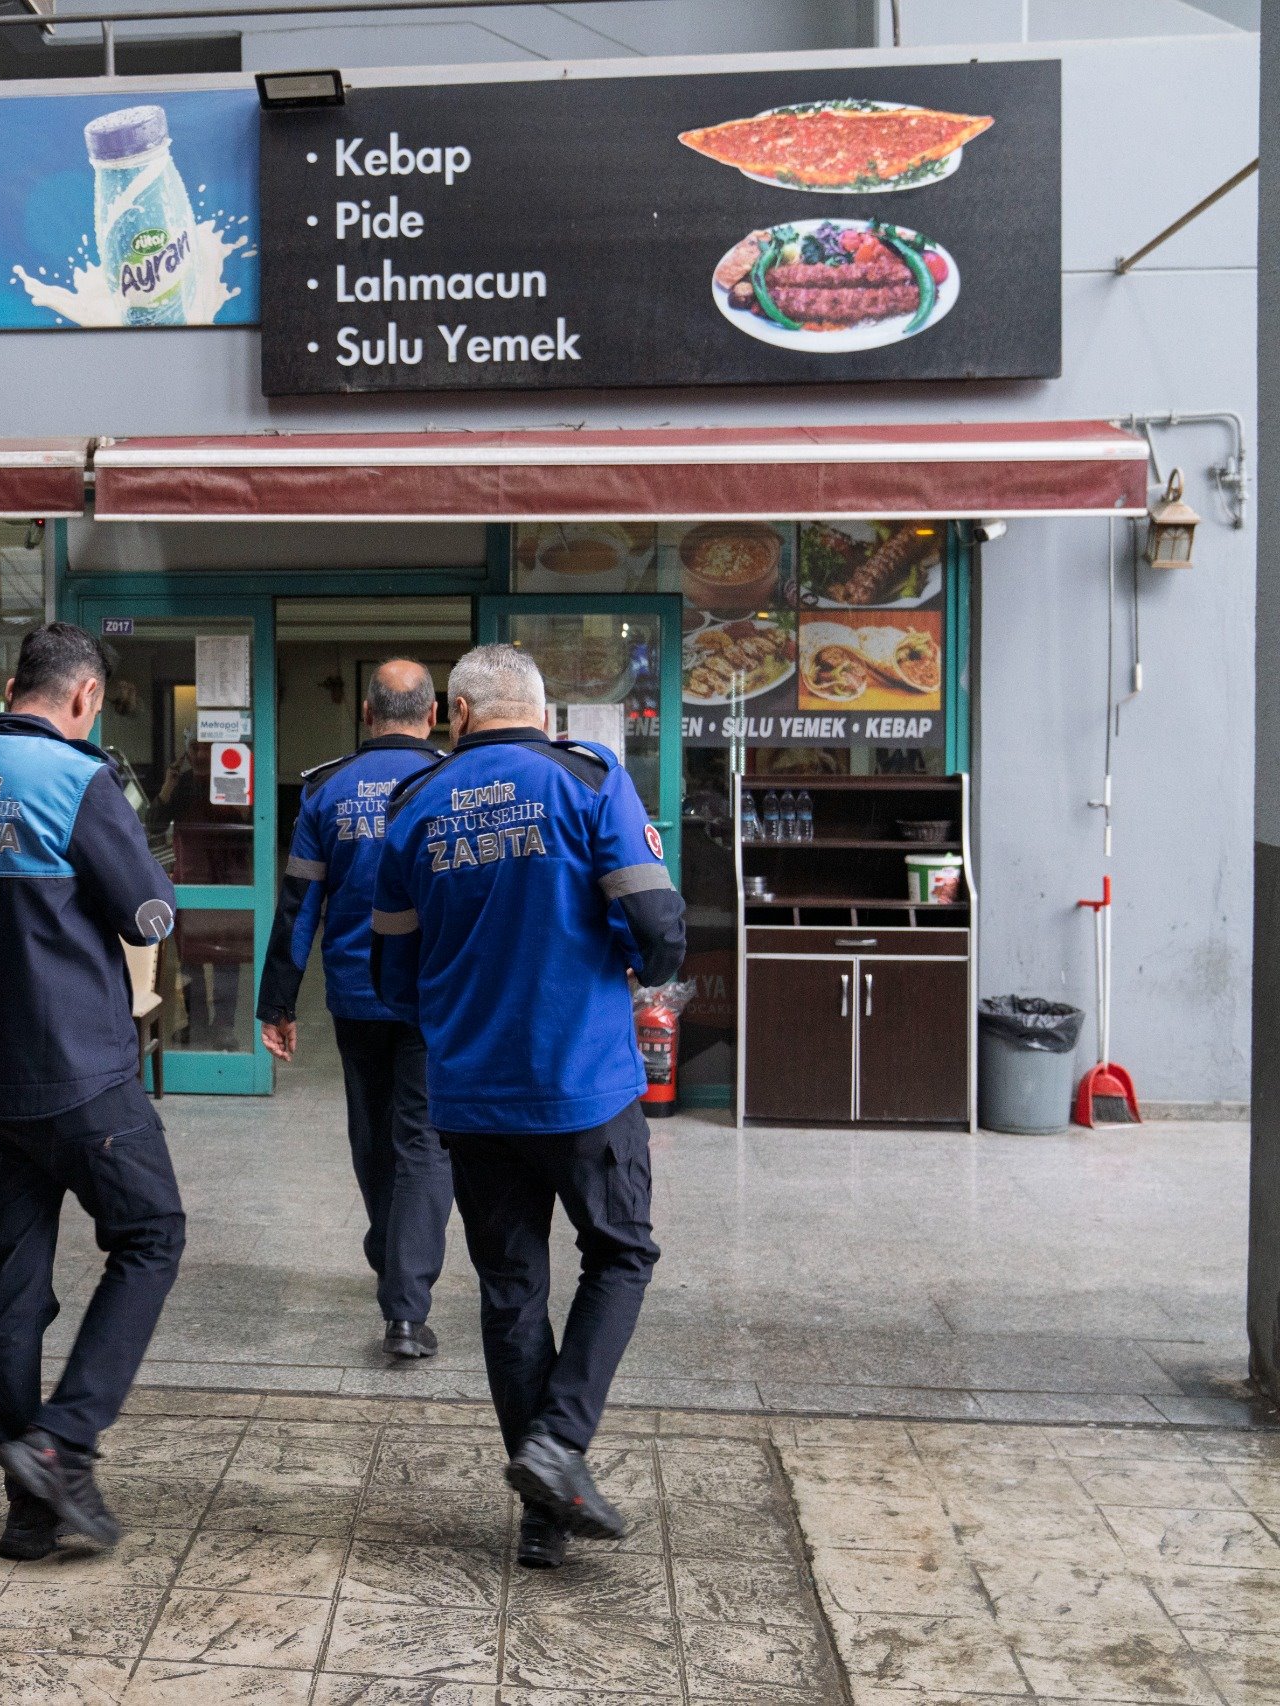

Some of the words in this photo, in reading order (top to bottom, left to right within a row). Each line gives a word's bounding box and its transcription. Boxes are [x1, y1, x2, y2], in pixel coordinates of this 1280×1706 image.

[335, 132, 472, 184] Kebap
[335, 195, 425, 240] Pide
[122, 230, 190, 297] Ayran
[335, 259, 548, 303] Lahmacun
[335, 322, 424, 367] Sulu
[436, 316, 581, 363] Yemek
[105, 620, 130, 632] Z017
[721, 716, 774, 739] SULU
[778, 716, 847, 739] YEMEK
[865, 716, 933, 739] KEBAP
[357, 777, 400, 798] İZMİ
[451, 780, 516, 811] İZMİR
[426, 800, 547, 838] BÜYÜKŞEHİR
[428, 824, 547, 873] ZABITA
